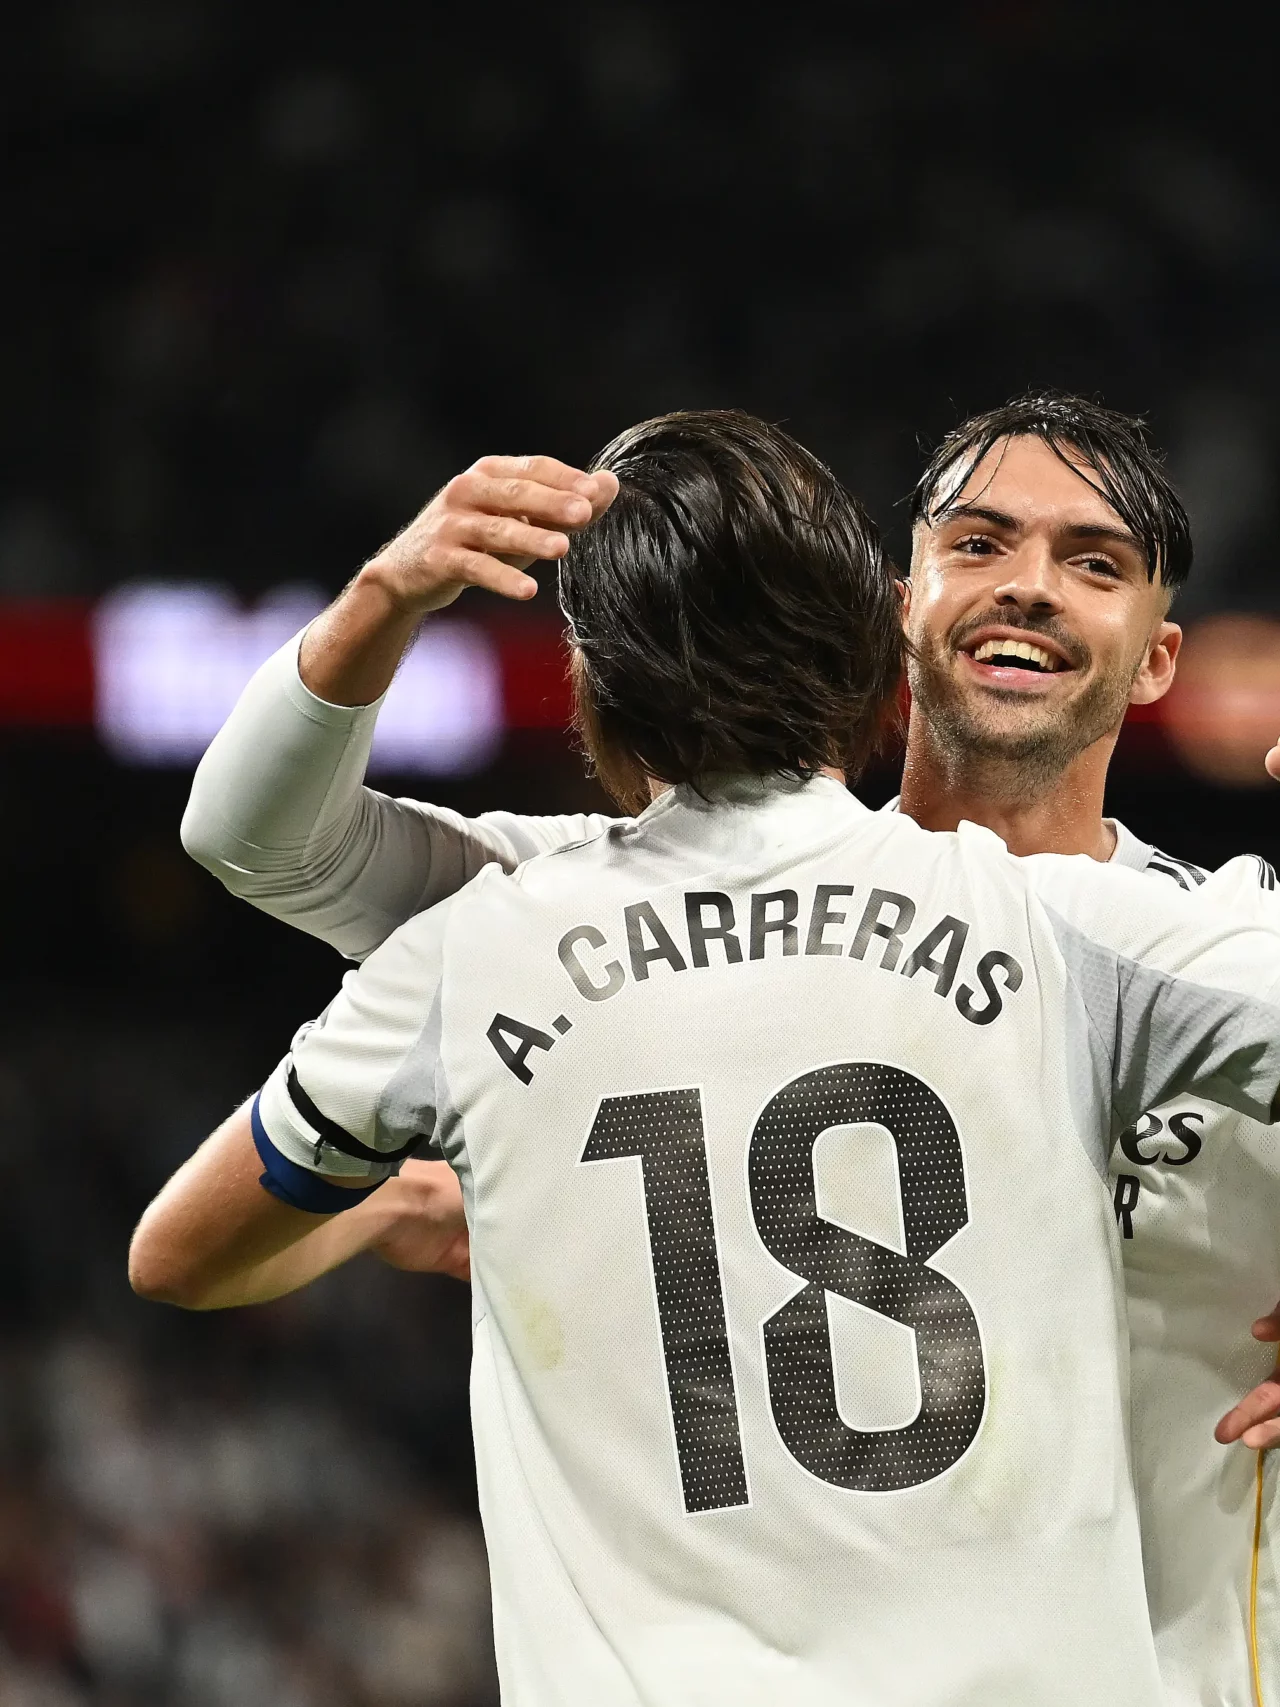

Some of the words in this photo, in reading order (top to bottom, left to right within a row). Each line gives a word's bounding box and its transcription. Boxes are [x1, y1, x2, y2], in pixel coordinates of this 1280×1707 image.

[485, 1012, 574, 1087] A.
[556, 884, 1024, 1026] CARRERAS
[578, 1060, 988, 1516] 18
